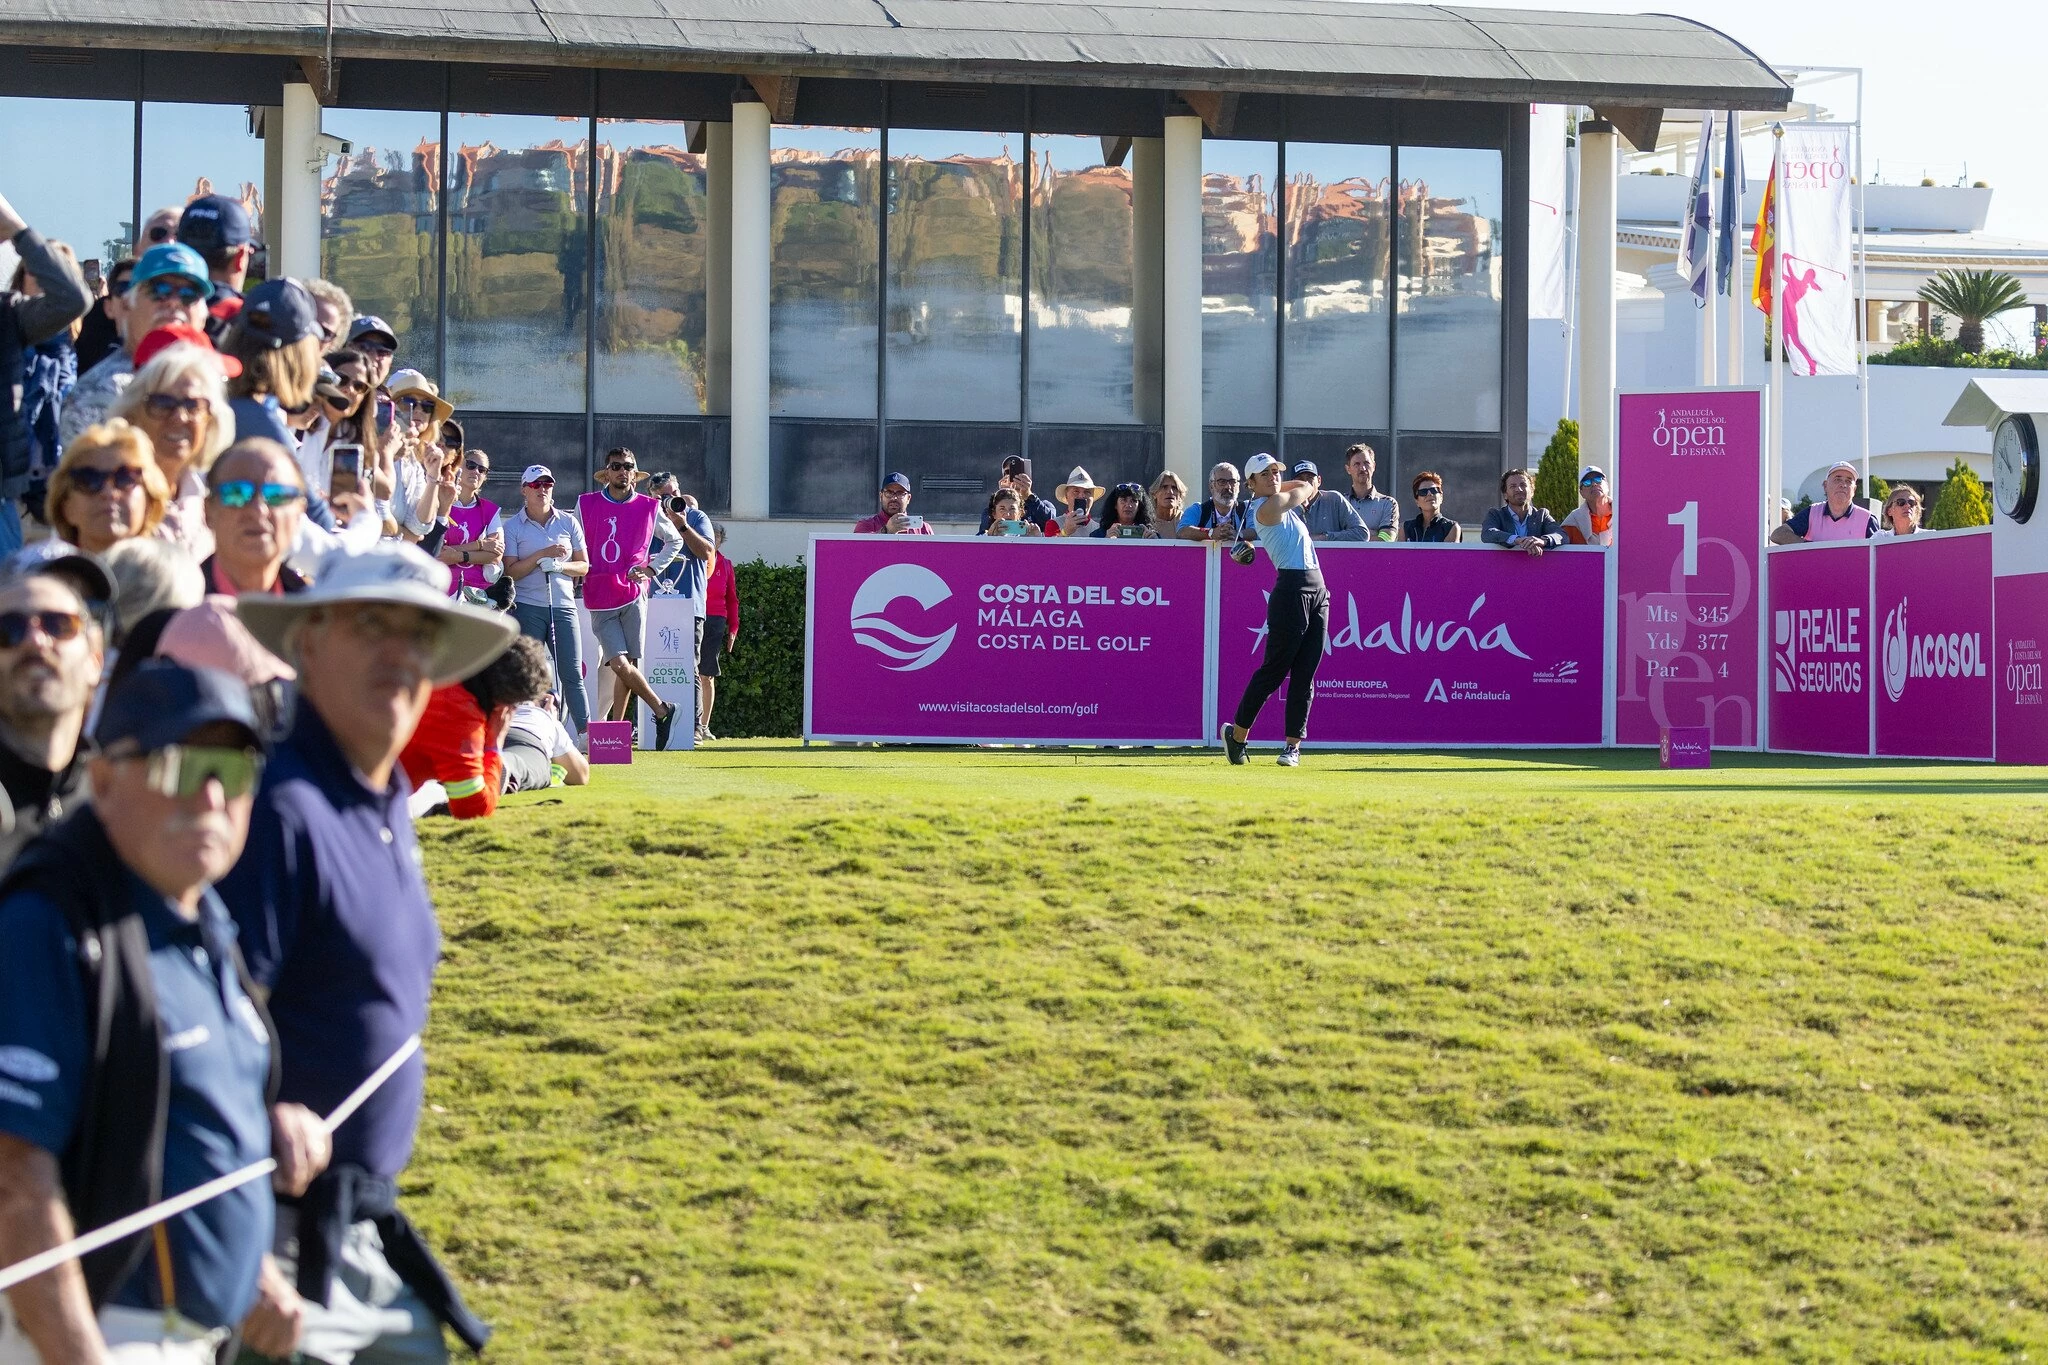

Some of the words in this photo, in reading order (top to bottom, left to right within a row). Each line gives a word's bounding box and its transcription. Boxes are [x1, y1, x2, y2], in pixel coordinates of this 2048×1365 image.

[1670, 408, 1714, 416] ANDALUCÍA
[1652, 425, 1726, 456] open
[1690, 447, 1726, 456] ESPAÑA
[1667, 501, 1698, 576] 1
[978, 584, 1061, 604] COSTA
[1067, 585, 1115, 605] DEL
[1120, 586, 1170, 606] SOL
[977, 605, 1084, 628] MÁLAGA
[1646, 605, 1678, 622] Mts
[1698, 606, 1729, 623] 345
[1800, 608, 1860, 652] REALE
[977, 634, 1046, 650] COSTA
[1052, 636, 1090, 650] DEL
[1097, 637, 1151, 651] GOLF
[1646, 632, 1679, 650] Yds
[1697, 633, 1729, 650] 377
[1910, 632, 1986, 678] ACOSOL
[653, 668, 686, 676] COSTA
[1646, 659, 1679, 677] Par
[1718, 661, 1729, 678] 4
[1800, 661, 1861, 693] SEGUROS
[648, 676, 668, 684] DEL
[670, 676, 691, 684] SOL
[1316, 679, 1344, 688] UNIÓN
[1346, 681, 1388, 689] EUROPEA
[1451, 681, 1478, 690] Junta
[2006, 663, 2043, 705] open
[1451, 691, 1463, 700] de
[1464, 690, 1511, 701] Andalucía
[918, 701, 1099, 716] www.visitacostadelsol.com/golf
